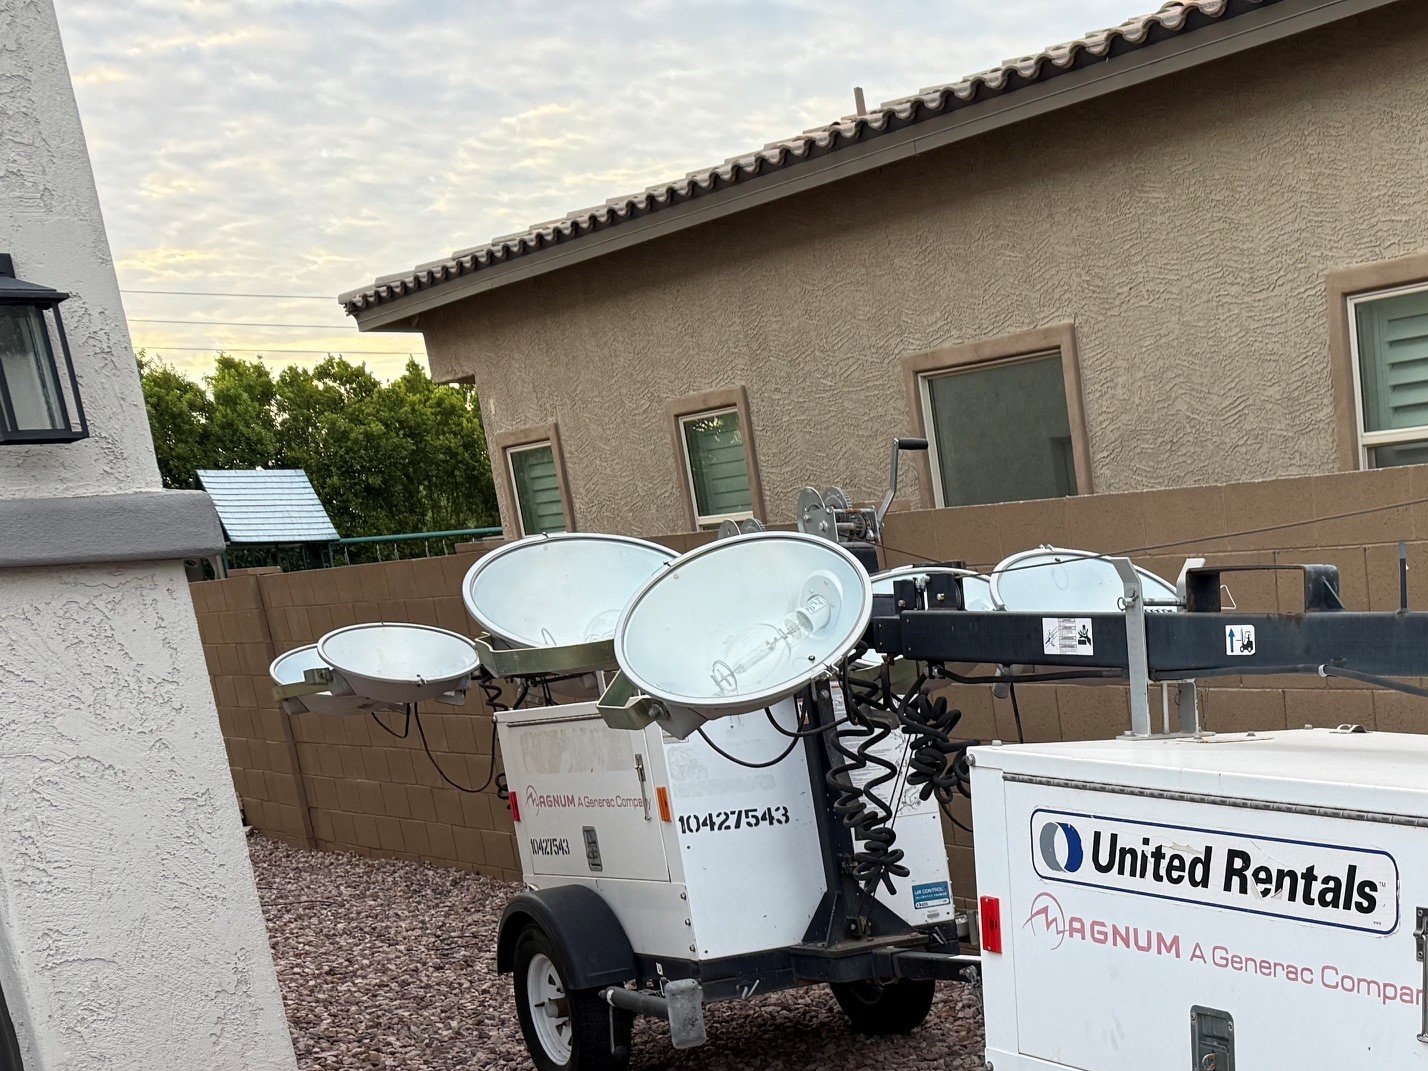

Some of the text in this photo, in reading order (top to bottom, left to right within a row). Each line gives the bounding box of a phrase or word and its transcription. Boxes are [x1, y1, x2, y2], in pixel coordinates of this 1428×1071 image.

[578, 796, 583, 808] A
[584, 796, 615, 808] Generac
[678, 805, 790, 834] 10427543
[530, 838, 570, 855] 10427543
[1092, 831, 1212, 889] United
[1223, 848, 1378, 915] Rentals
[1189, 942, 1207, 964] A
[1212, 945, 1314, 985] Generac
